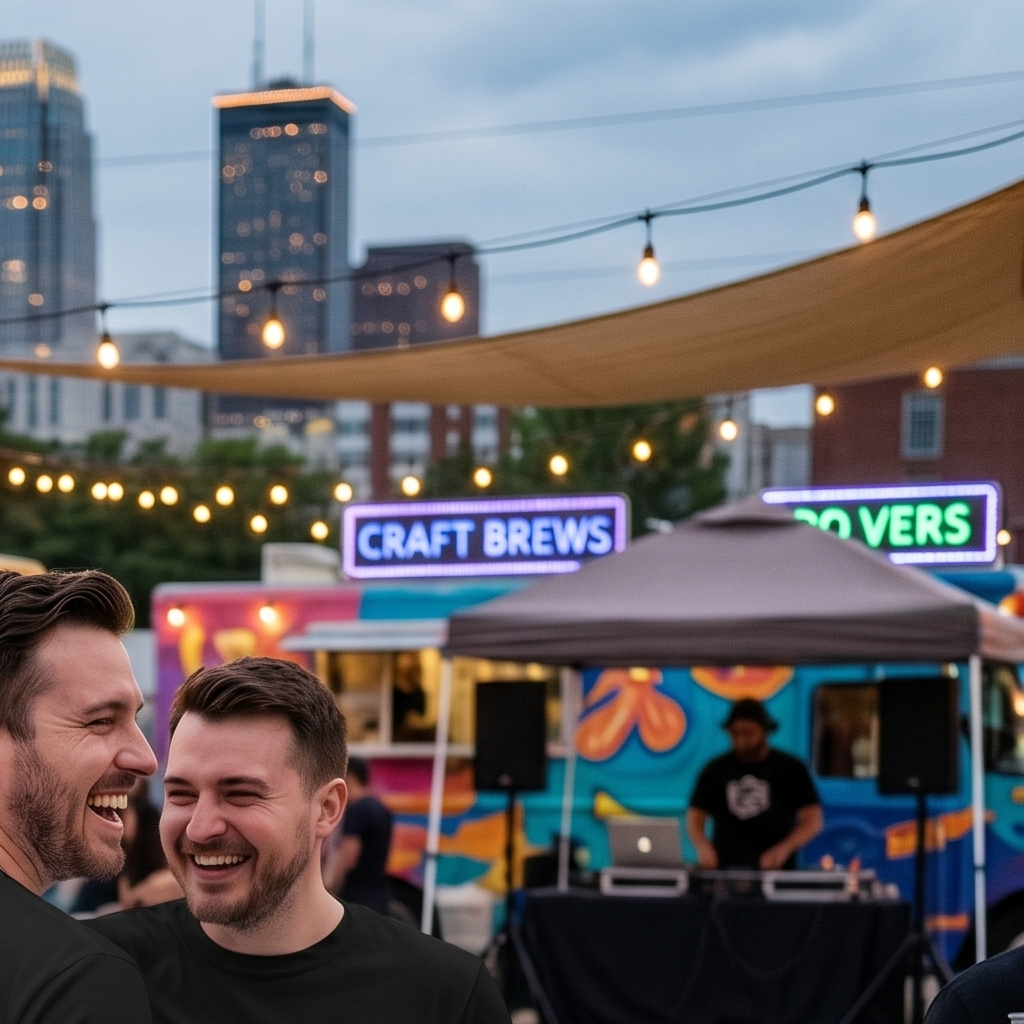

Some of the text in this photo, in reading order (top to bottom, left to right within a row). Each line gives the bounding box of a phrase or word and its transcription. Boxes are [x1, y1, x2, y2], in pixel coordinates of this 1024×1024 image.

[356, 515, 613, 561] CRAFT BREWS
[858, 502, 972, 548] VERS
